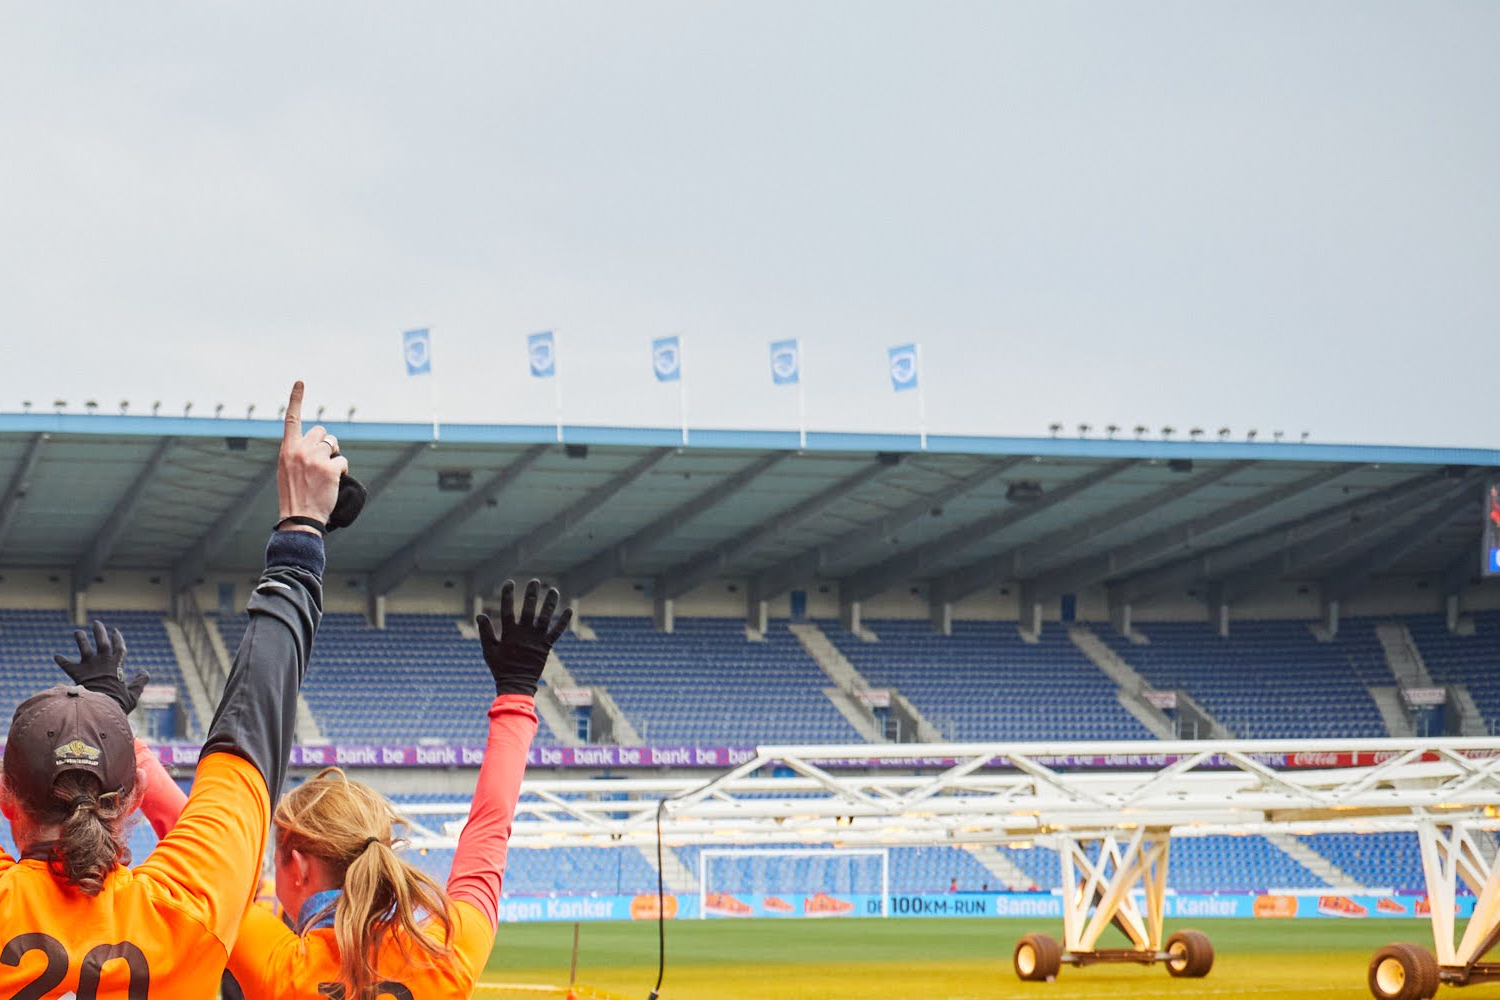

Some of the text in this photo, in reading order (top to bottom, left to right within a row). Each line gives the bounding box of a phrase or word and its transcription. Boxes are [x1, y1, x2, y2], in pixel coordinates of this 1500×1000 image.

[548, 898, 614, 919] Kanker
[996, 896, 1060, 916] Samen
[1176, 898, 1239, 917] Kanker
